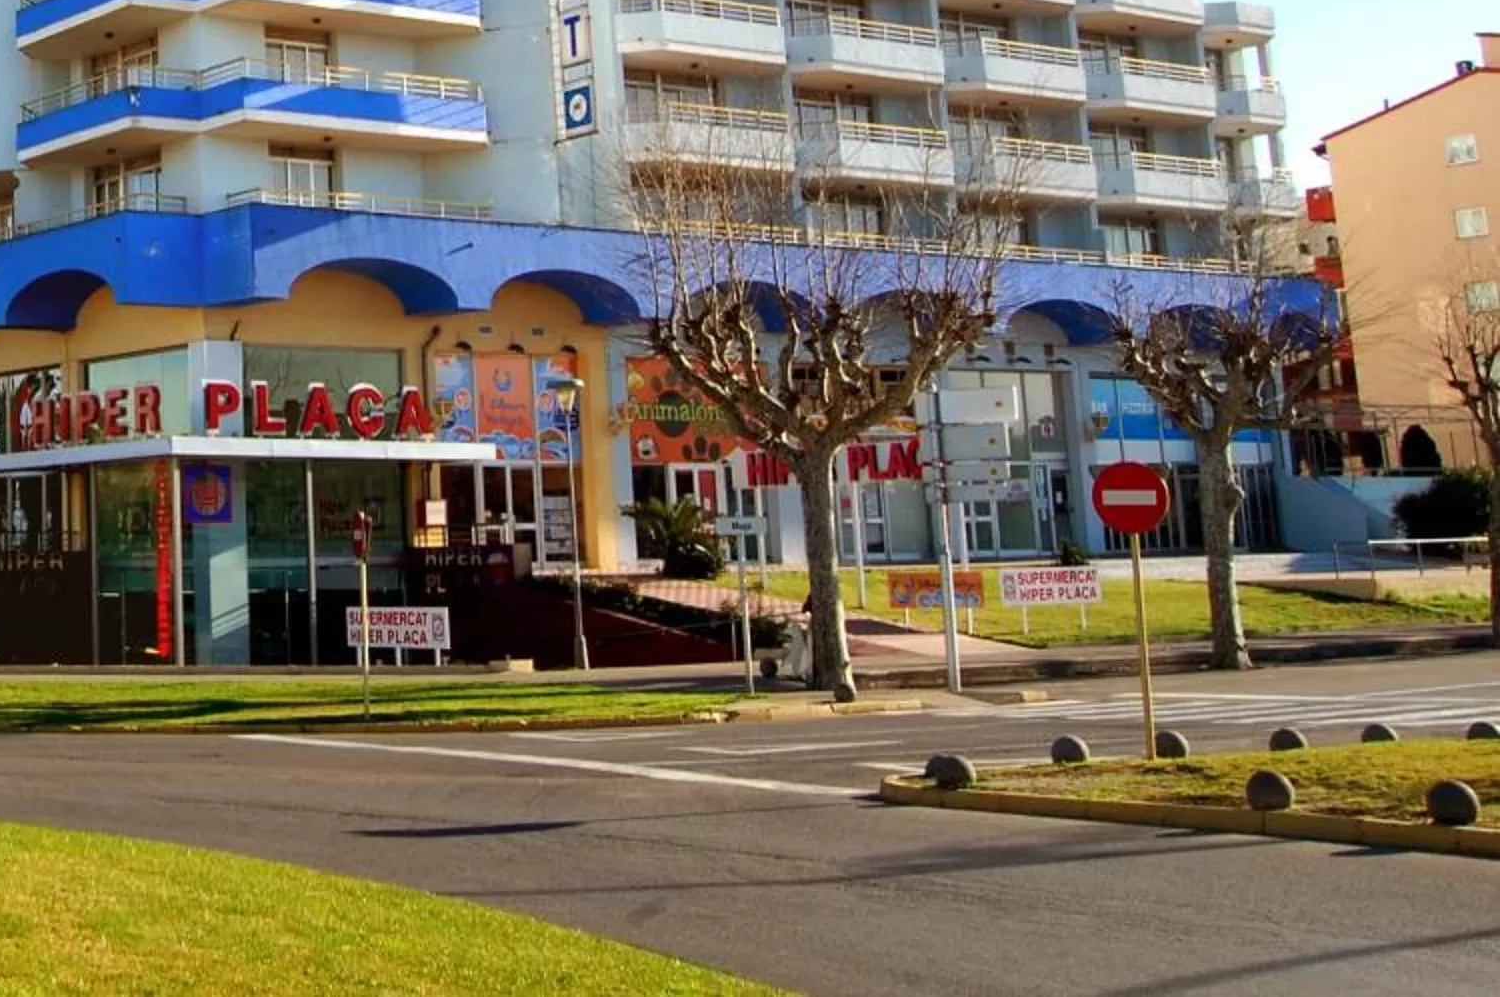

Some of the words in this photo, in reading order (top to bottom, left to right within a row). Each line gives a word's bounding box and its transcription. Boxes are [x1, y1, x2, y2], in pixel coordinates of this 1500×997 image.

[31, 382, 163, 447] HIPER
[1017, 570, 1098, 585] SUPERMERCAT
[1019, 587, 1055, 601] HIPER
[349, 611, 428, 626] SUERMERCAT
[350, 629, 383, 644] HIER
